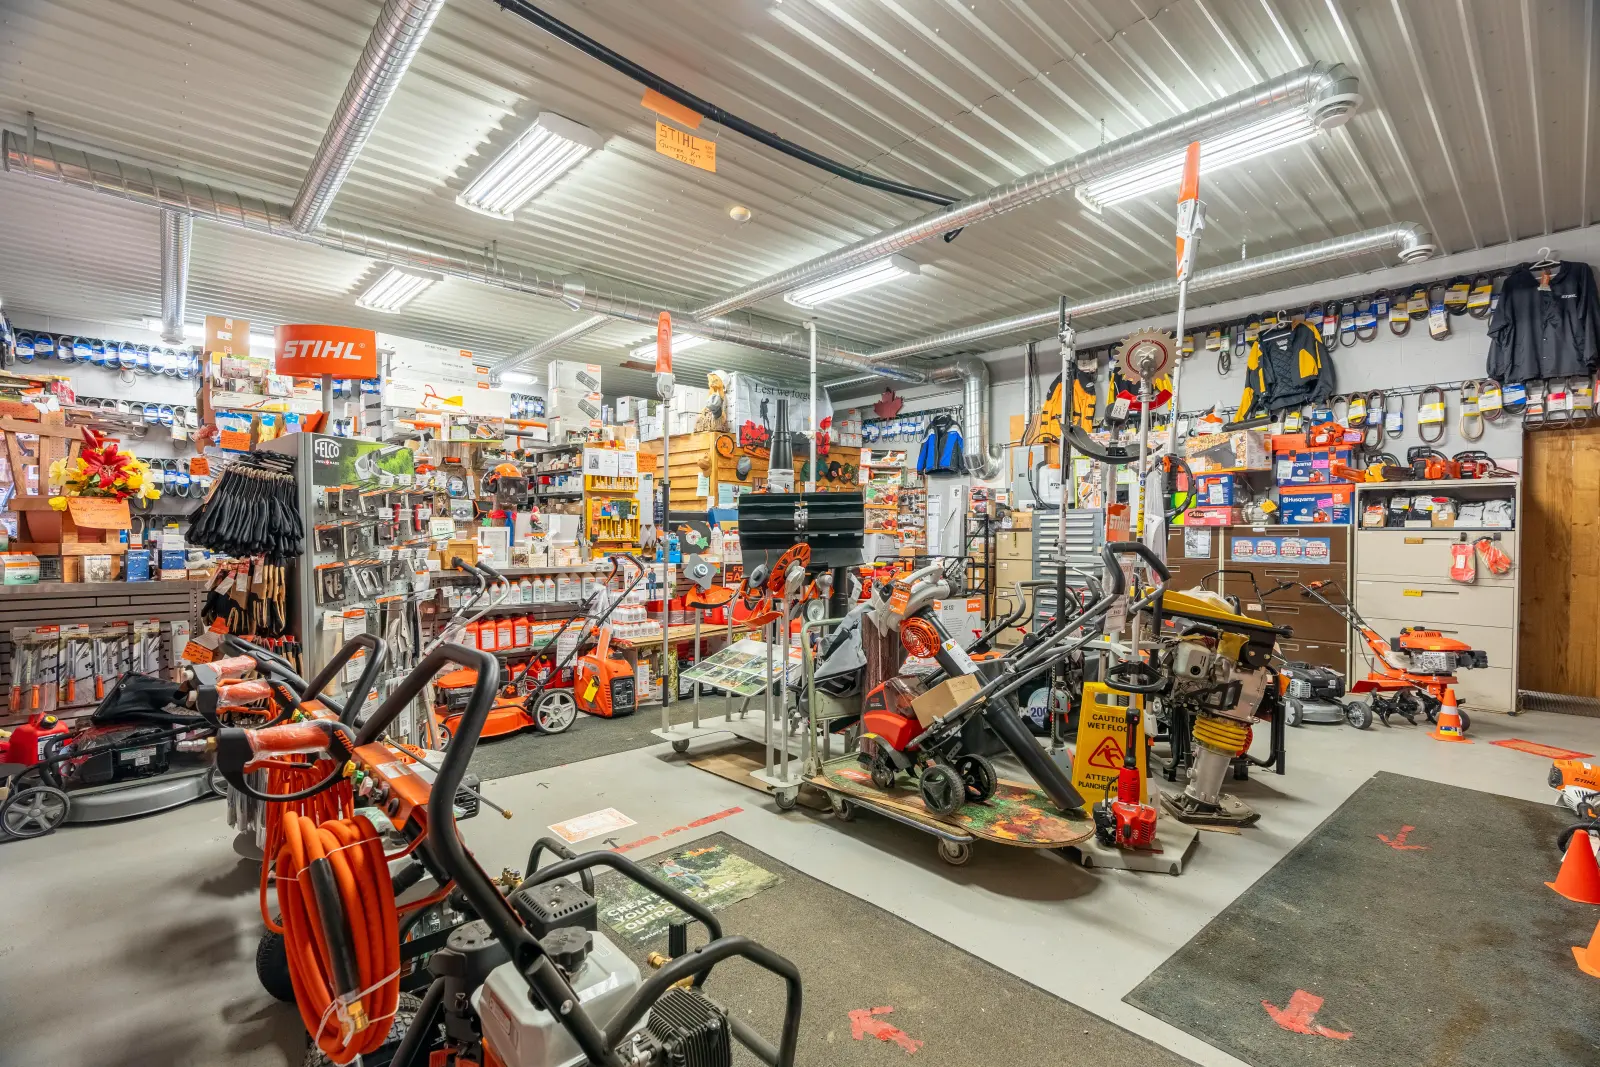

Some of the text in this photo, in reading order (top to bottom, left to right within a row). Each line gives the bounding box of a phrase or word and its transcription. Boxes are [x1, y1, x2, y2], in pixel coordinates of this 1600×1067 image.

[660, 124, 700, 151] STIHL
[282, 340, 362, 360] STIHL
[754, 383, 775, 395] Lest
[777, 387, 789, 397] we
[315, 438, 340, 458] FELCO
[1110, 516, 1130, 530] STIHL
[278, 684, 294, 702] STIHL
[1088, 722, 1105, 730] WET
[1092, 713, 1128, 724] CAUTIO
[1574, 777, 1598, 787] STIHL
[607, 893, 660, 917] CREATE
[615, 903, 657, 923] YOUR
